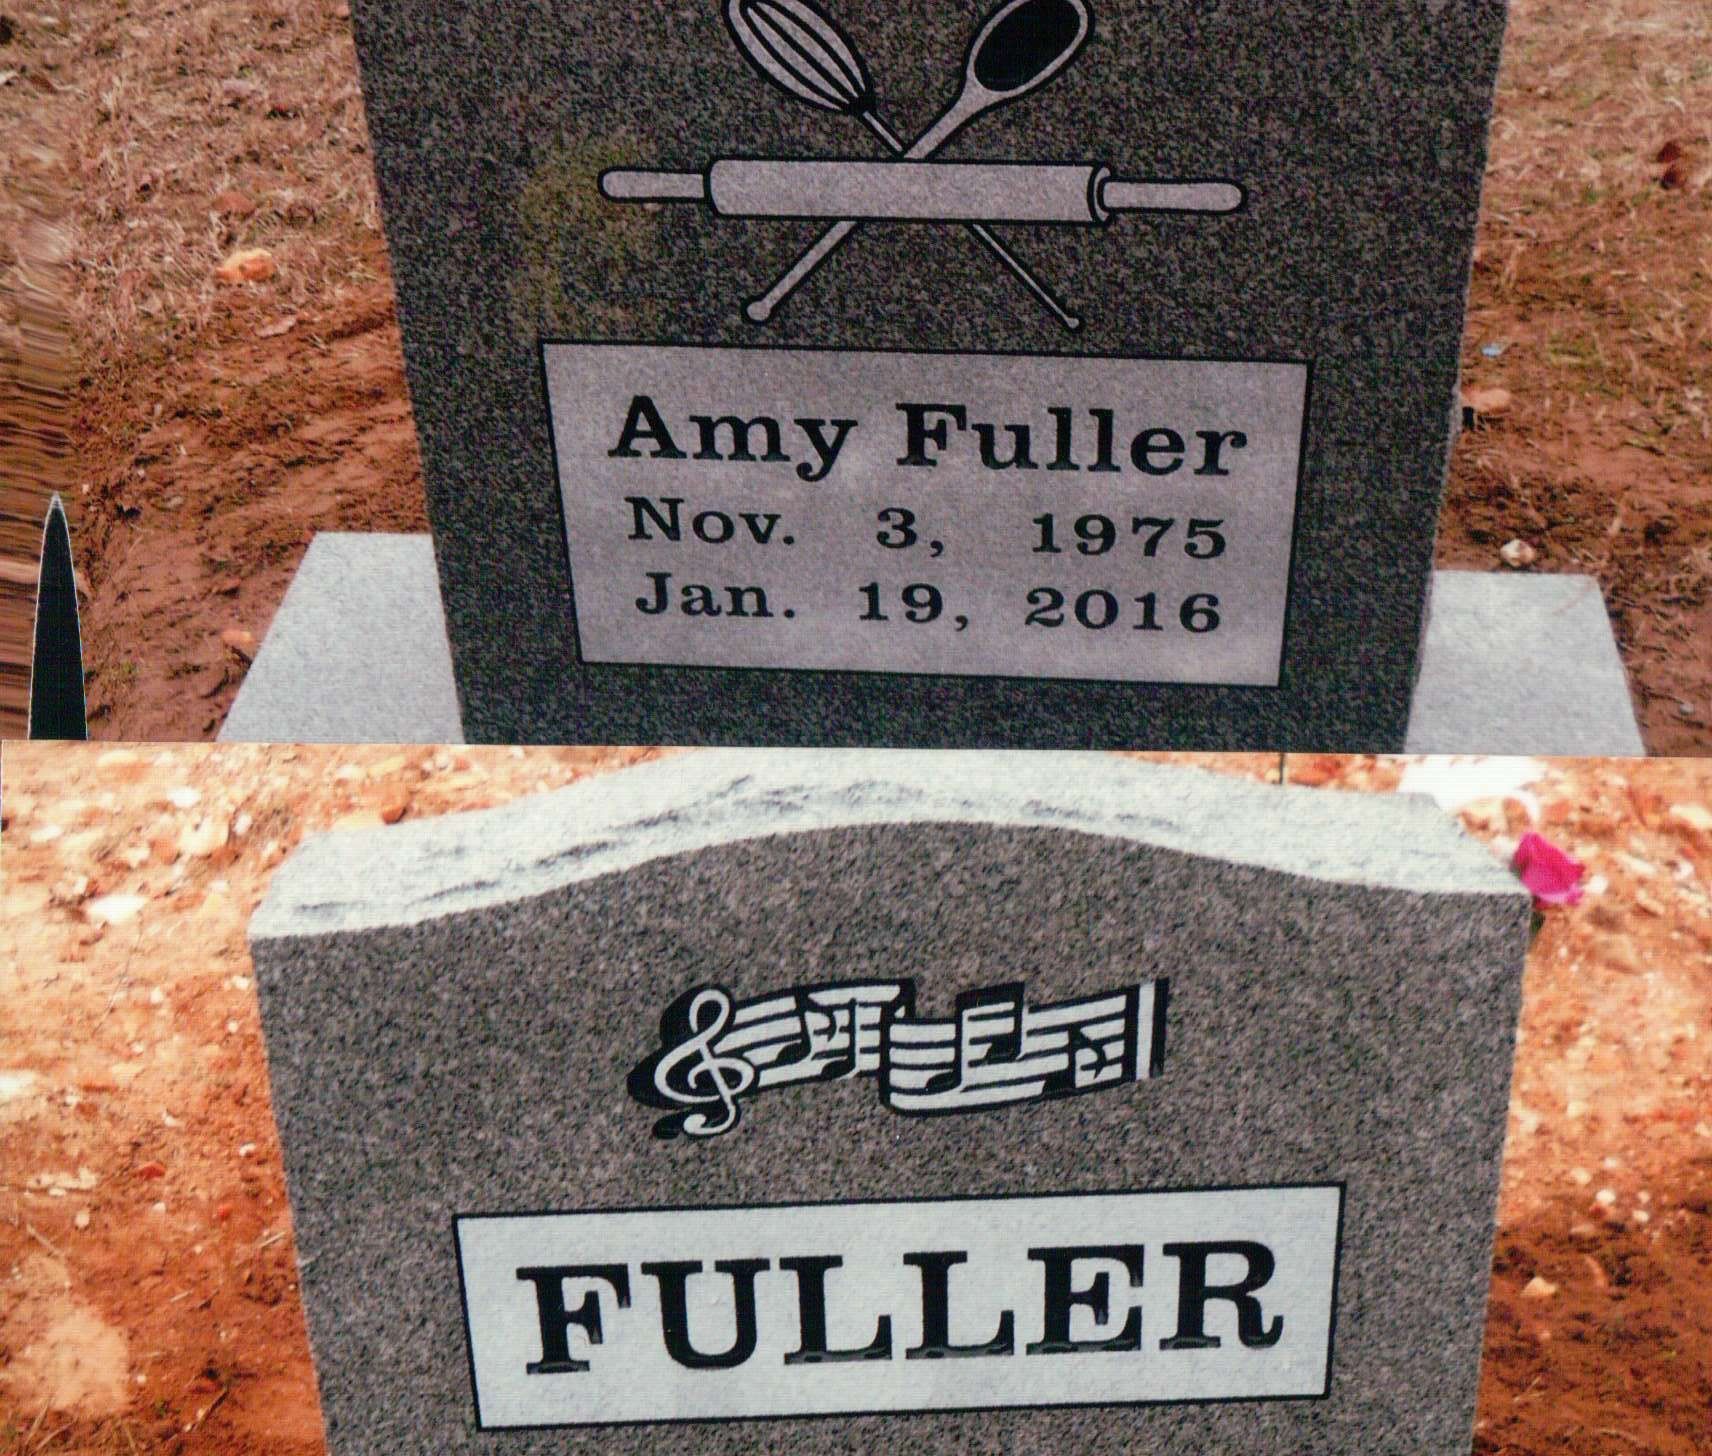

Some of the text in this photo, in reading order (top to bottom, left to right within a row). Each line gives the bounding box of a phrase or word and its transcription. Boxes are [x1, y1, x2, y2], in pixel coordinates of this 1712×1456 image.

[608, 395, 1248, 482] Amy Fuller
[625, 497, 1228, 560] Nov. 3, 1975
[636, 572, 1220, 634] Jan. 19, 2016
[516, 1241, 1283, 1375] FULLER
